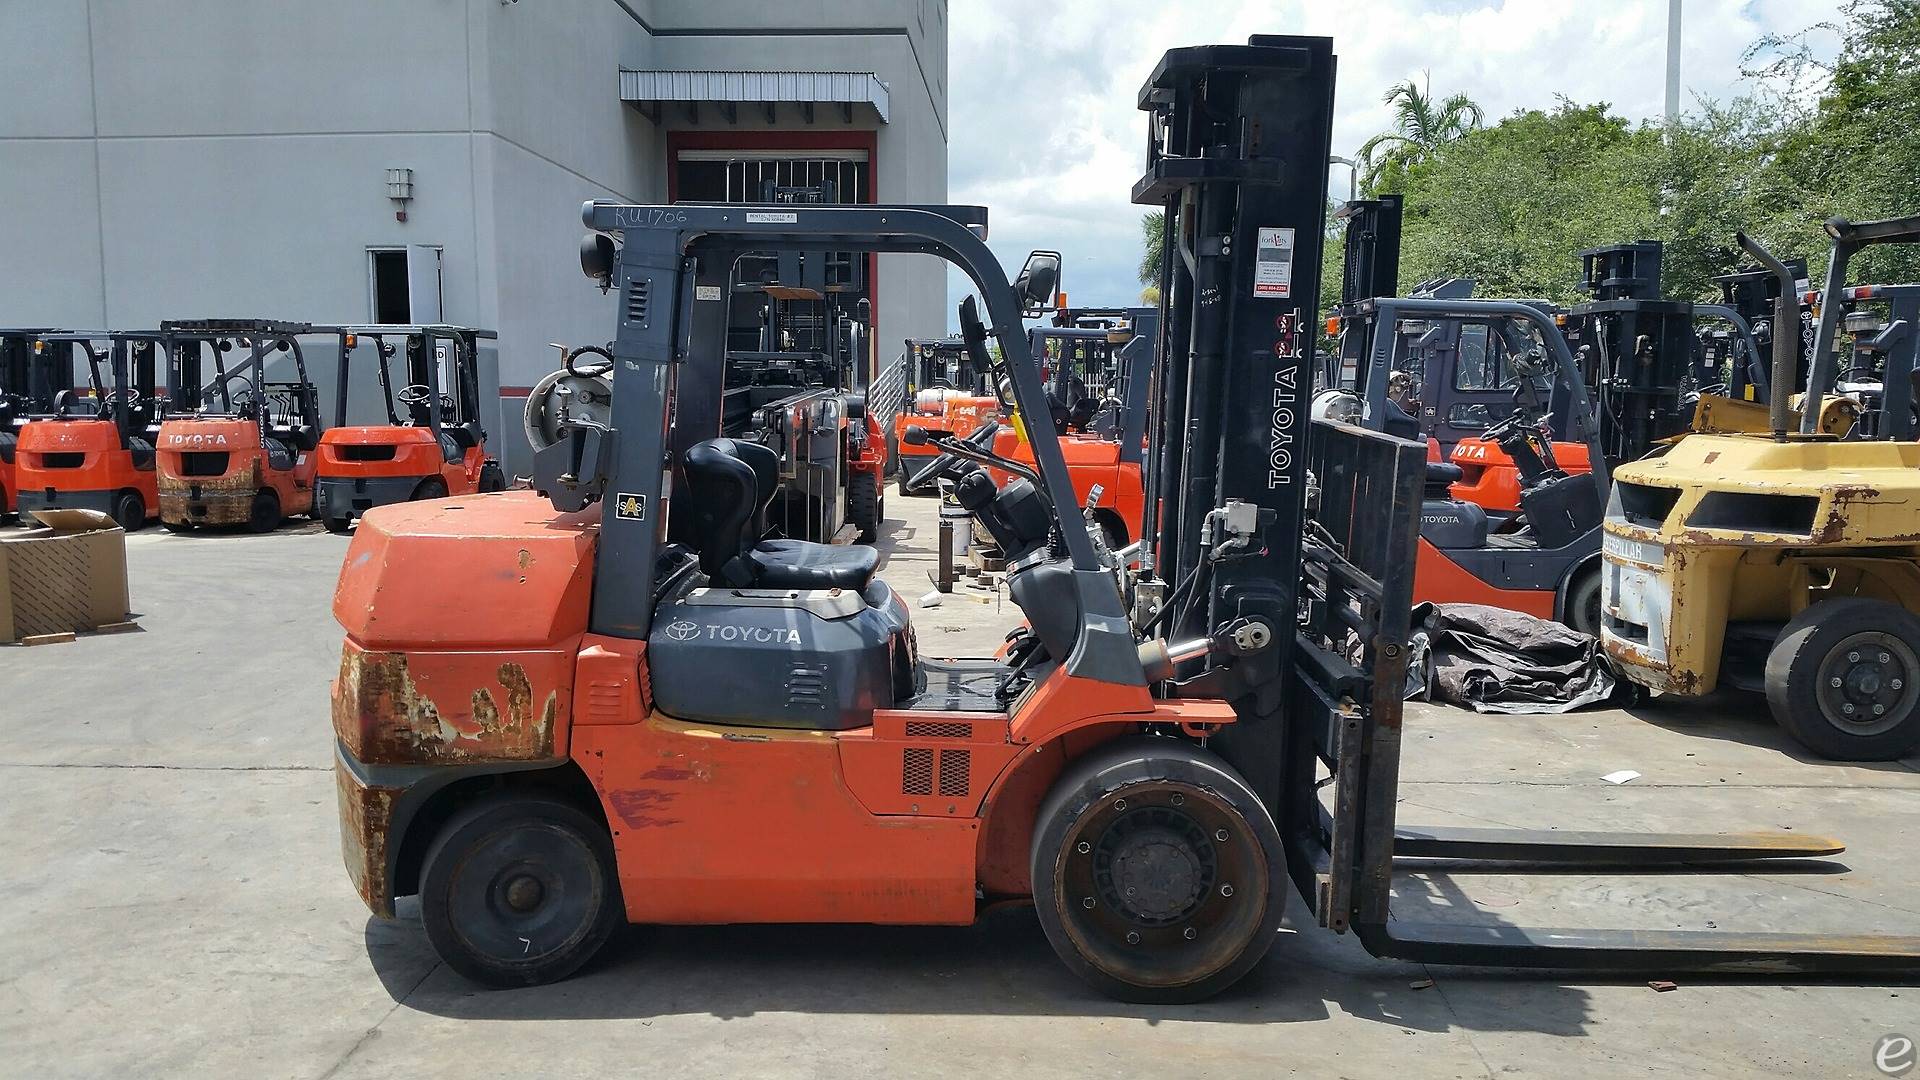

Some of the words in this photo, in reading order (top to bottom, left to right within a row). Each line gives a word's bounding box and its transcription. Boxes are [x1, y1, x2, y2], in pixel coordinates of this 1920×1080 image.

[1268, 366, 1298, 490] TOYOTA
[168, 434, 227, 444] TOYOTA
[1424, 516, 1460, 524] TOYOTA
[706, 624, 802, 645] TOYOTA
